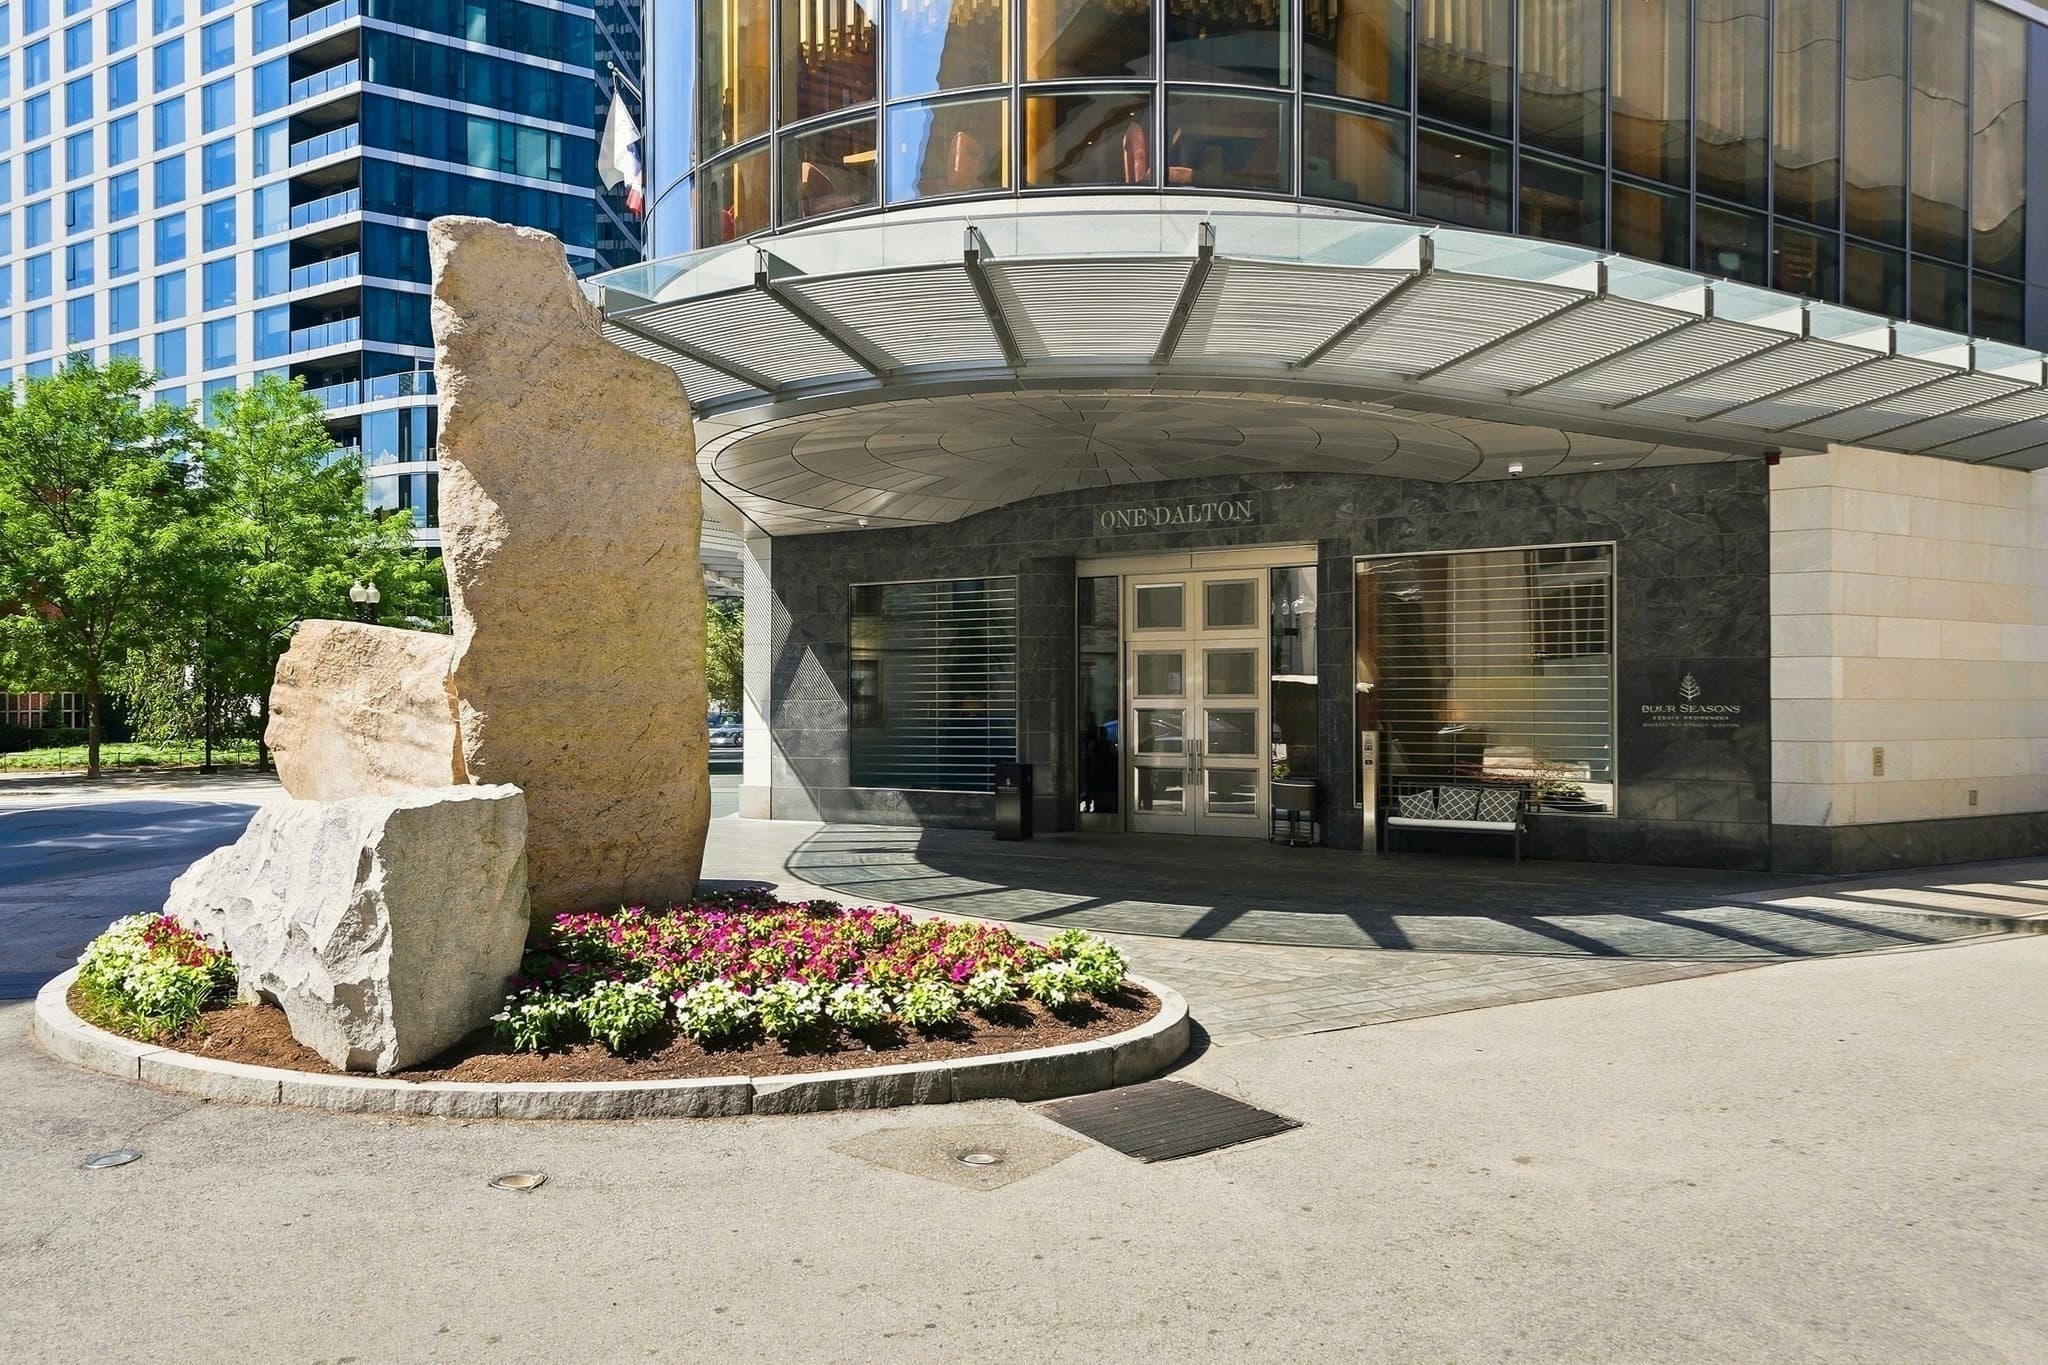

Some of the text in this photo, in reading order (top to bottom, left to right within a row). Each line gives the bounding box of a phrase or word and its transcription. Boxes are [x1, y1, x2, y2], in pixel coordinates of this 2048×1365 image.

[1100, 499, 1254, 530] ONE DALTON
[1679, 703, 1742, 714] SEASONS
